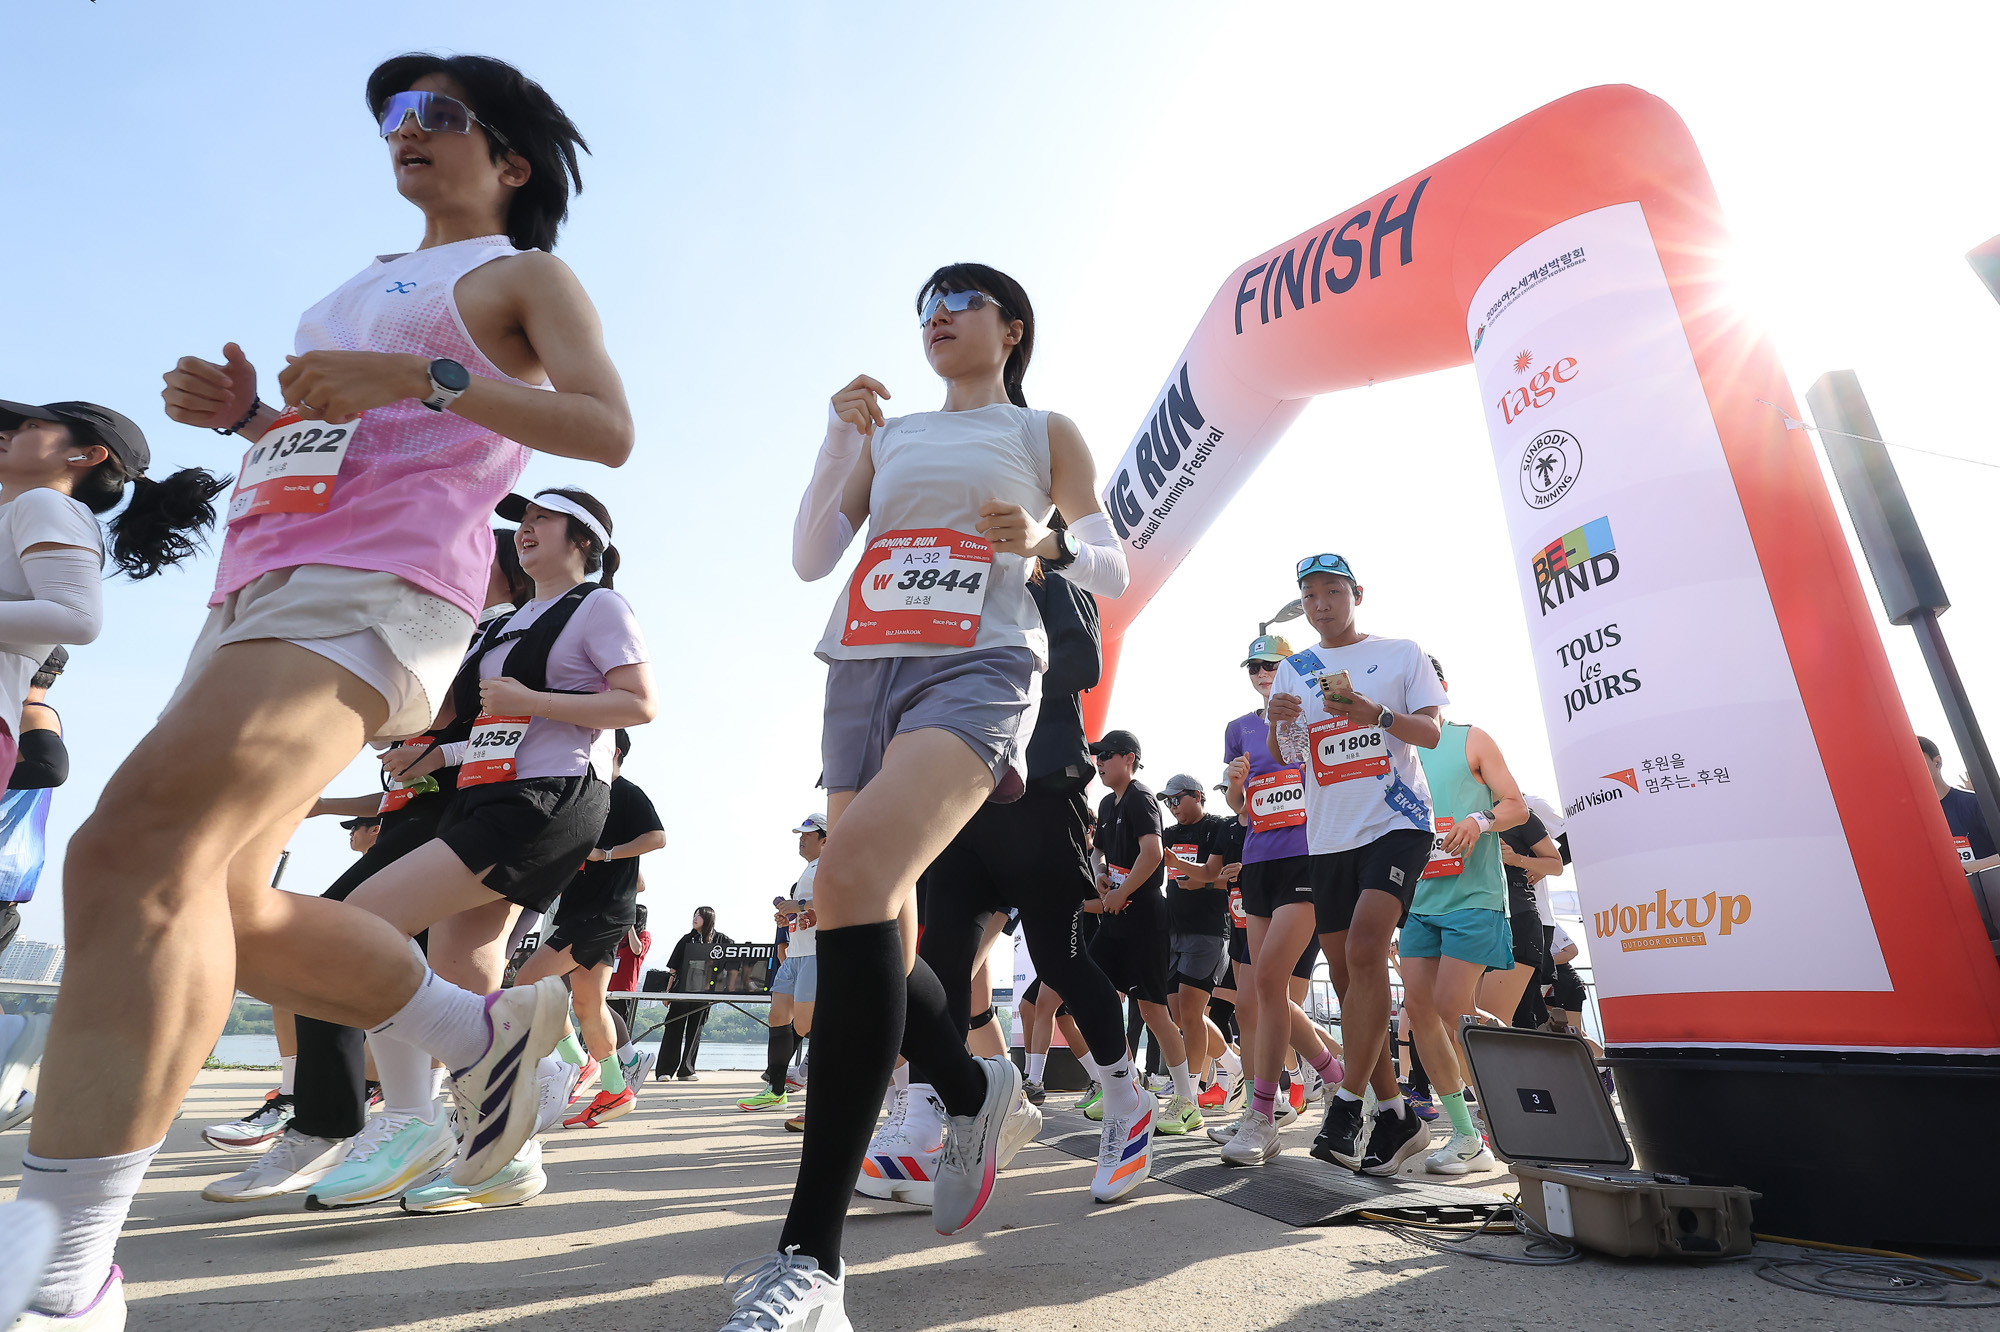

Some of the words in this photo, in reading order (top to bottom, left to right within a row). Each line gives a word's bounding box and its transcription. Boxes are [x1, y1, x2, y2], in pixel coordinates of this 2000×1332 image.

[1234, 176, 1432, 335] FINISH
[1521, 276, 1548, 296] EXHIBITION
[1547, 266, 1566, 278] YEOSU
[1567, 258, 1587, 269] KOREA
[1136, 360, 1205, 500] RUN
[268, 428, 347, 461] 1322
[1523, 434, 1568, 472] SUNBODY
[1132, 516, 1162, 550] Casual
[1152, 475, 1195, 520] Running
[1182, 425, 1225, 476] Festival
[1534, 474, 1573, 505] TANNING
[912, 536, 938, 547] RUN
[959, 540, 988, 551] 10km
[903, 552, 940, 565] A-32
[873, 573, 894, 591] W
[897, 568, 983, 594] 3844
[1538, 551, 1620, 617] KIND
[905, 595, 932, 605] 김소정
[1556, 623, 1622, 668] TOUS
[1579, 660, 1602, 683] les
[1563, 668, 1642, 722] JOURS
[1310, 722, 1336, 734] BURNING
[1336, 719, 1349, 729] RUN
[471, 730, 522, 748] 4258
[1324, 744, 1335, 756] M
[1339, 732, 1381, 753] 1808
[1641, 753, 1686, 773] 후원을
[1697, 767, 1731, 785] 후원
[1255, 797, 1264, 807] W
[1266, 788, 1303, 804] 4000
[1565, 795, 1586, 819] World
[1584, 787, 1623, 808] Vision
[1622, 937, 1662, 950] OUTDOOR
[1664, 934, 1704, 946] OUTLET
[1532, 1093, 1541, 1105] 3
